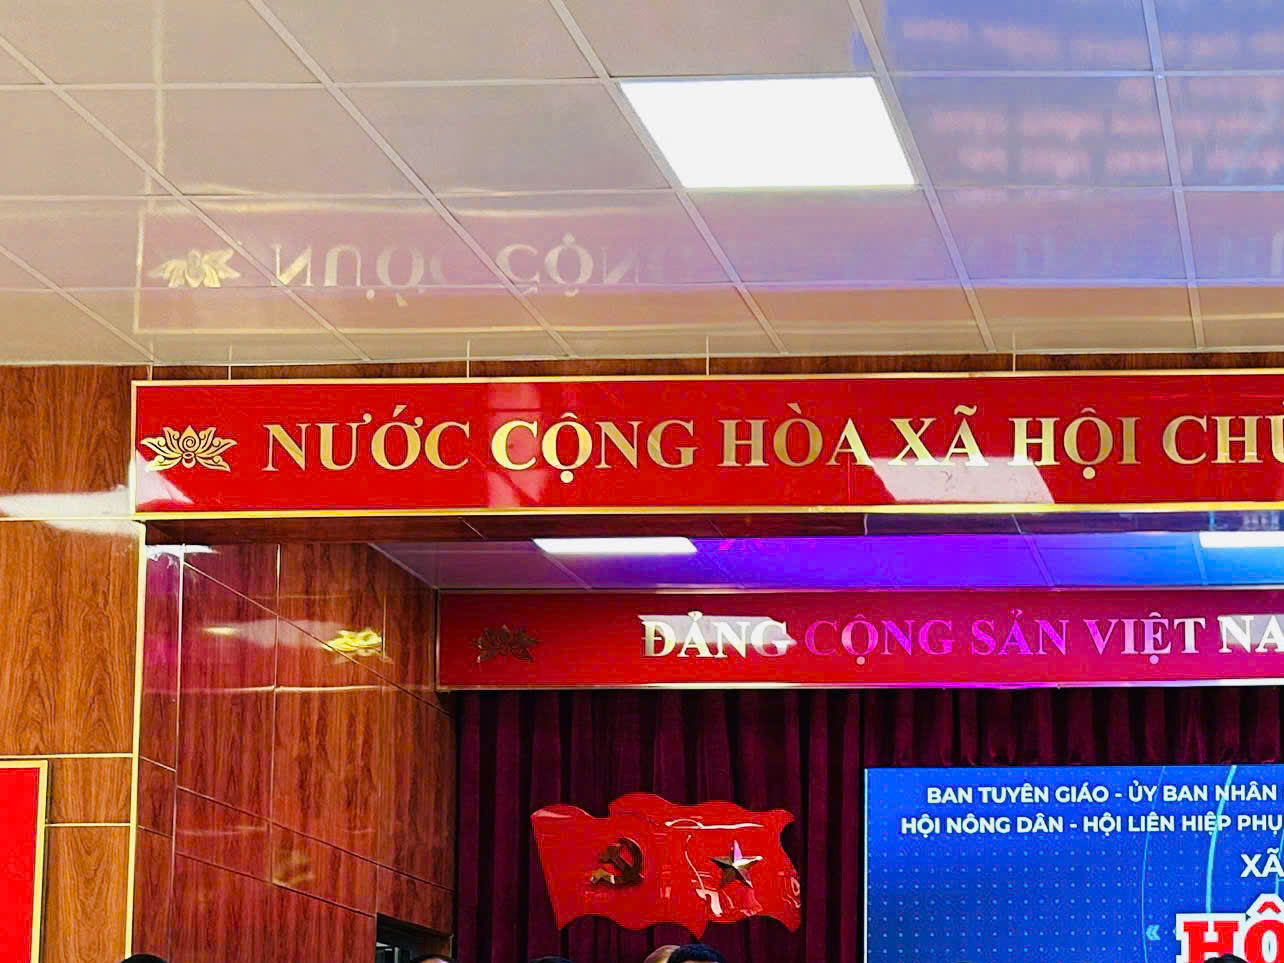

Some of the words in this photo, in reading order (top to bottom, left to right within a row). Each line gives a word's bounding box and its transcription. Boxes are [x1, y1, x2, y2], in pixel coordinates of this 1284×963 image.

[262, 405, 470, 472] NƯỚC
[490, 411, 696, 483] CỘNG
[718, 403, 872, 468] HÒA
[886, 405, 992, 468] XÃ
[1012, 407, 1140, 478] HỘI
[642, 610, 790, 657] ĐẢNG
[804, 613, 953, 665] CỘNG
[969, 609, 1068, 656] SẢN
[1083, 611, 1206, 665] VIỆT
[927, 787, 972, 804] BAN
[978, 783, 1048, 803] TUYÊN
[1055, 782, 1109, 802] GIÁO
[1128, 780, 1157, 802] ỦY
[1163, 785, 1208, 802] BAN
[1215, 781, 1277, 802] NHÂN
[901, 813, 940, 838] HỘI
[946, 813, 1011, 834] NÔNG
[1016, 812, 1063, 833] DÂN
[1083, 811, 1121, 837] HỘI
[1128, 811, 1174, 832] LIÊN
[1182, 811, 1231, 836] HIỆP
[1237, 814, 1283, 836] PHỤ
[1240, 848, 1284, 878] XÃ
